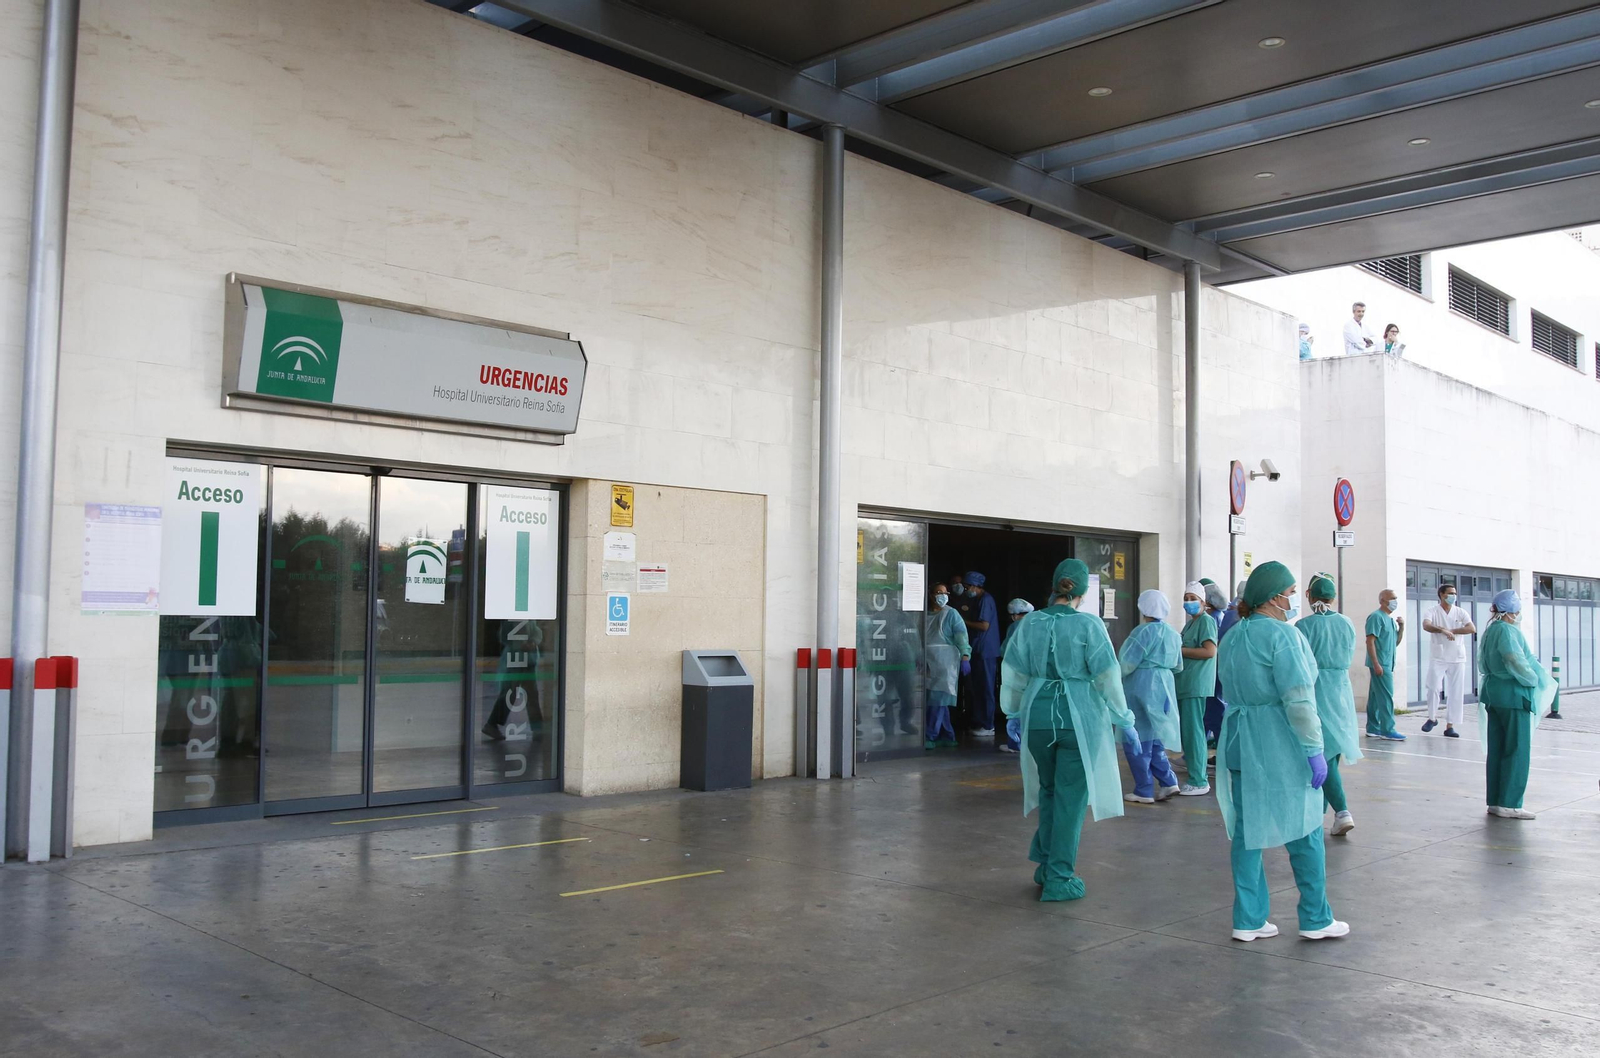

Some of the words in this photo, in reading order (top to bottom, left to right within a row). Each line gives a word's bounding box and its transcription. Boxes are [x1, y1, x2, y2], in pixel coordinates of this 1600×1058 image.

[267, 370, 284, 379] JUNTA
[287, 373, 294, 381] DE
[480, 364, 568, 396] URGENCIAS
[433, 385, 468, 402] Hospital
[470, 390, 520, 408] Universitario
[523, 397, 544, 411] Reina
[178, 480, 244, 504] Acceso
[500, 505, 547, 525] Acceso
[414, 576, 420, 584] DE
[871, 526, 889, 746] URGENCIAS
